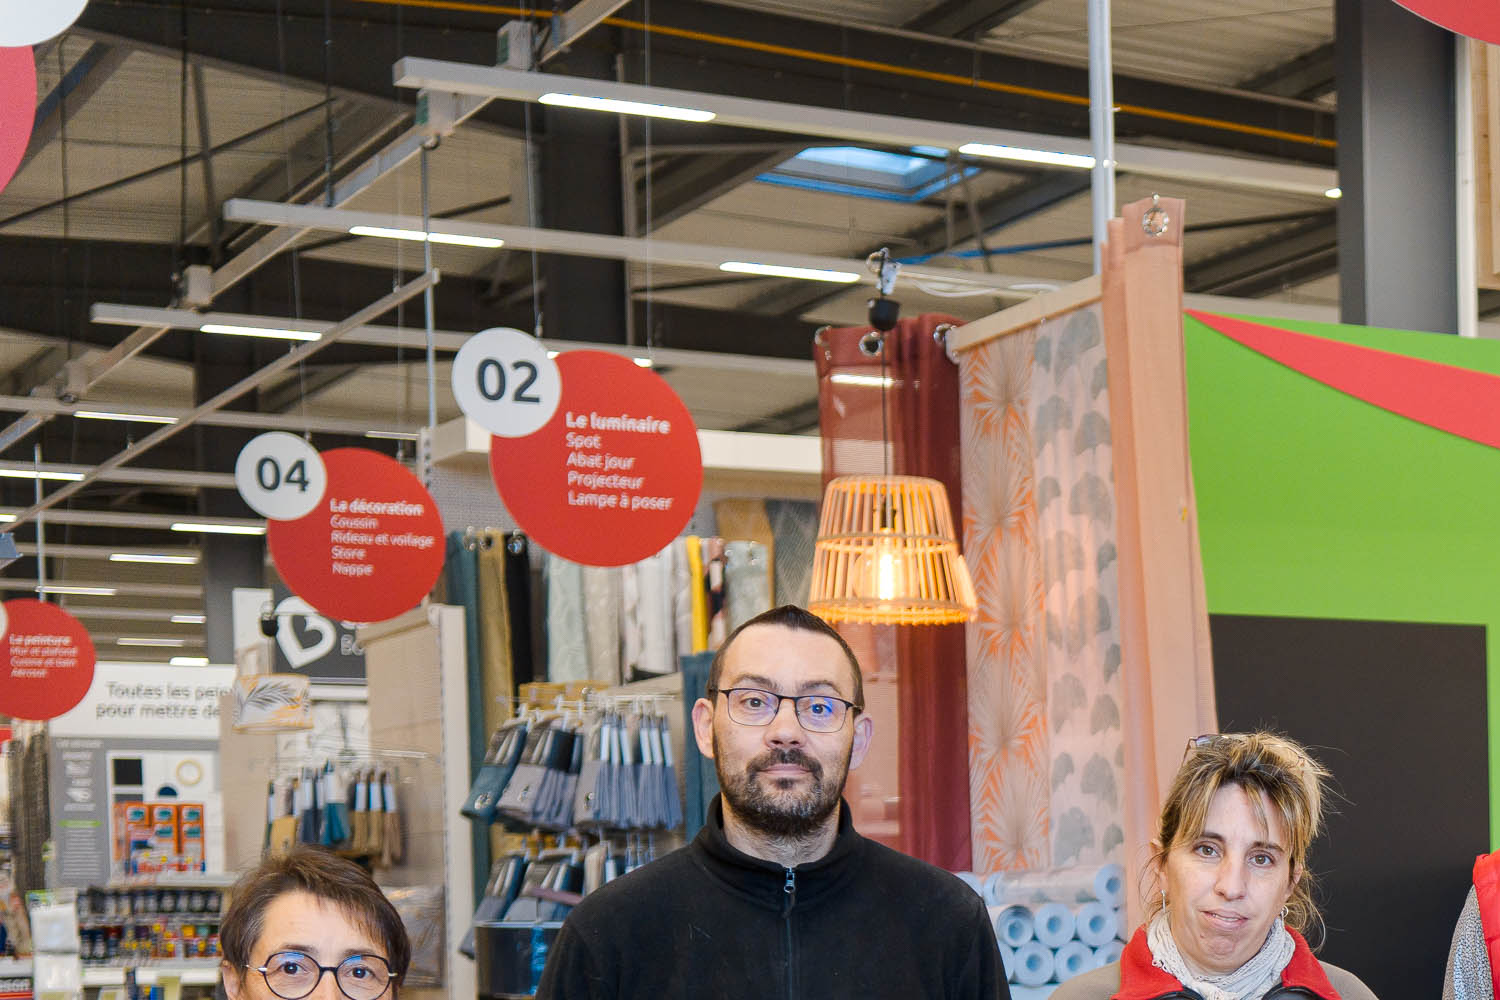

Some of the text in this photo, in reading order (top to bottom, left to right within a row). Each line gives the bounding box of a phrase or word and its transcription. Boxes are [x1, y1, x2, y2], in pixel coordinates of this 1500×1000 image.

[477, 357, 540, 403] 02
[566, 411, 672, 435] Le luminaire
[566, 433, 602, 450] Spot
[567, 452, 636, 472] Abat jour
[257, 457, 310, 492] 04
[568, 470, 645, 490] Projecteur
[330, 498, 424, 516] La décoration
[568, 490, 673, 511] Lampe à poser
[330, 516, 378, 530] Coussin
[331, 530, 435, 549] Rideau et voilage
[331, 546, 367, 560] Store
[332, 562, 374, 577] Nappe
[107, 681, 161, 698] Toutes
[167, 681, 190, 698] les
[96, 703, 135, 720] pour
[140, 703, 198, 717] mettre
